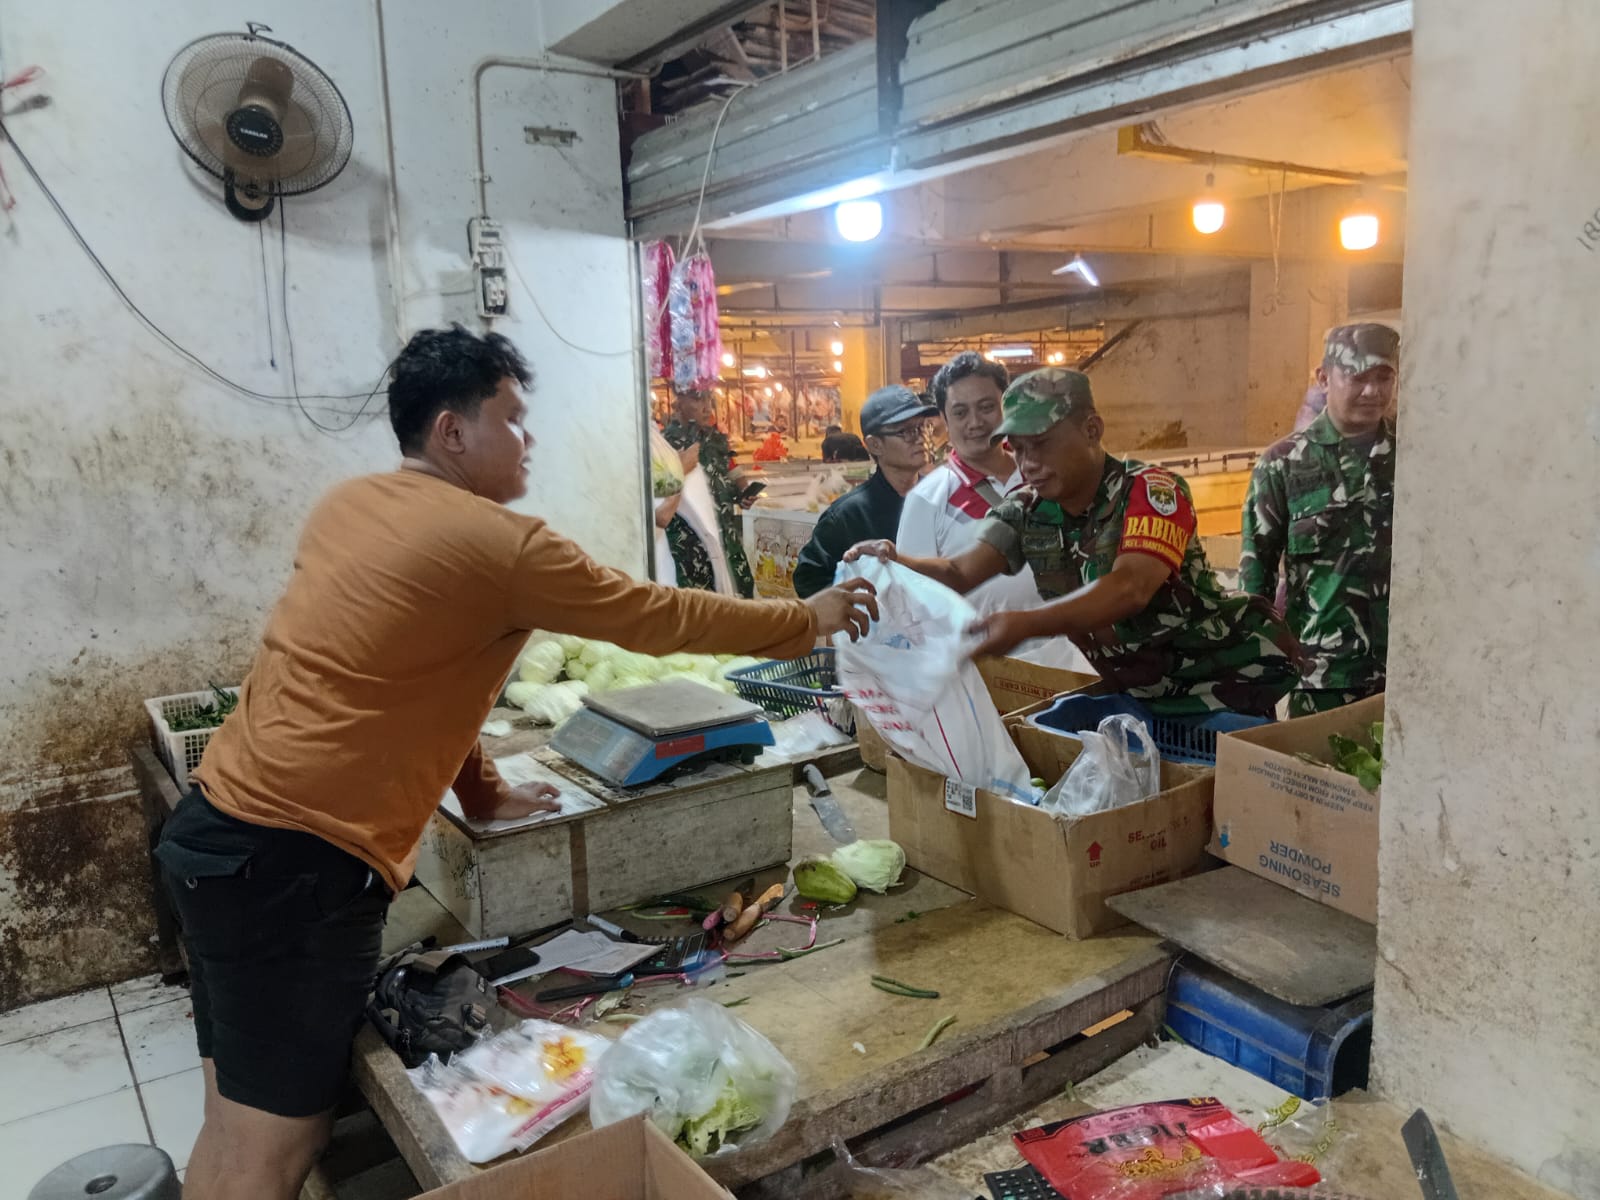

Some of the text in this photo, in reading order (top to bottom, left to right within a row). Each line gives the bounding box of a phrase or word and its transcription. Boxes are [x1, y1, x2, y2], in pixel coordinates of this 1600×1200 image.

[1308, 783, 1330, 798] FROM
[1269, 840, 1332, 874] POWDER
[1259, 854, 1341, 897] SEASONING
